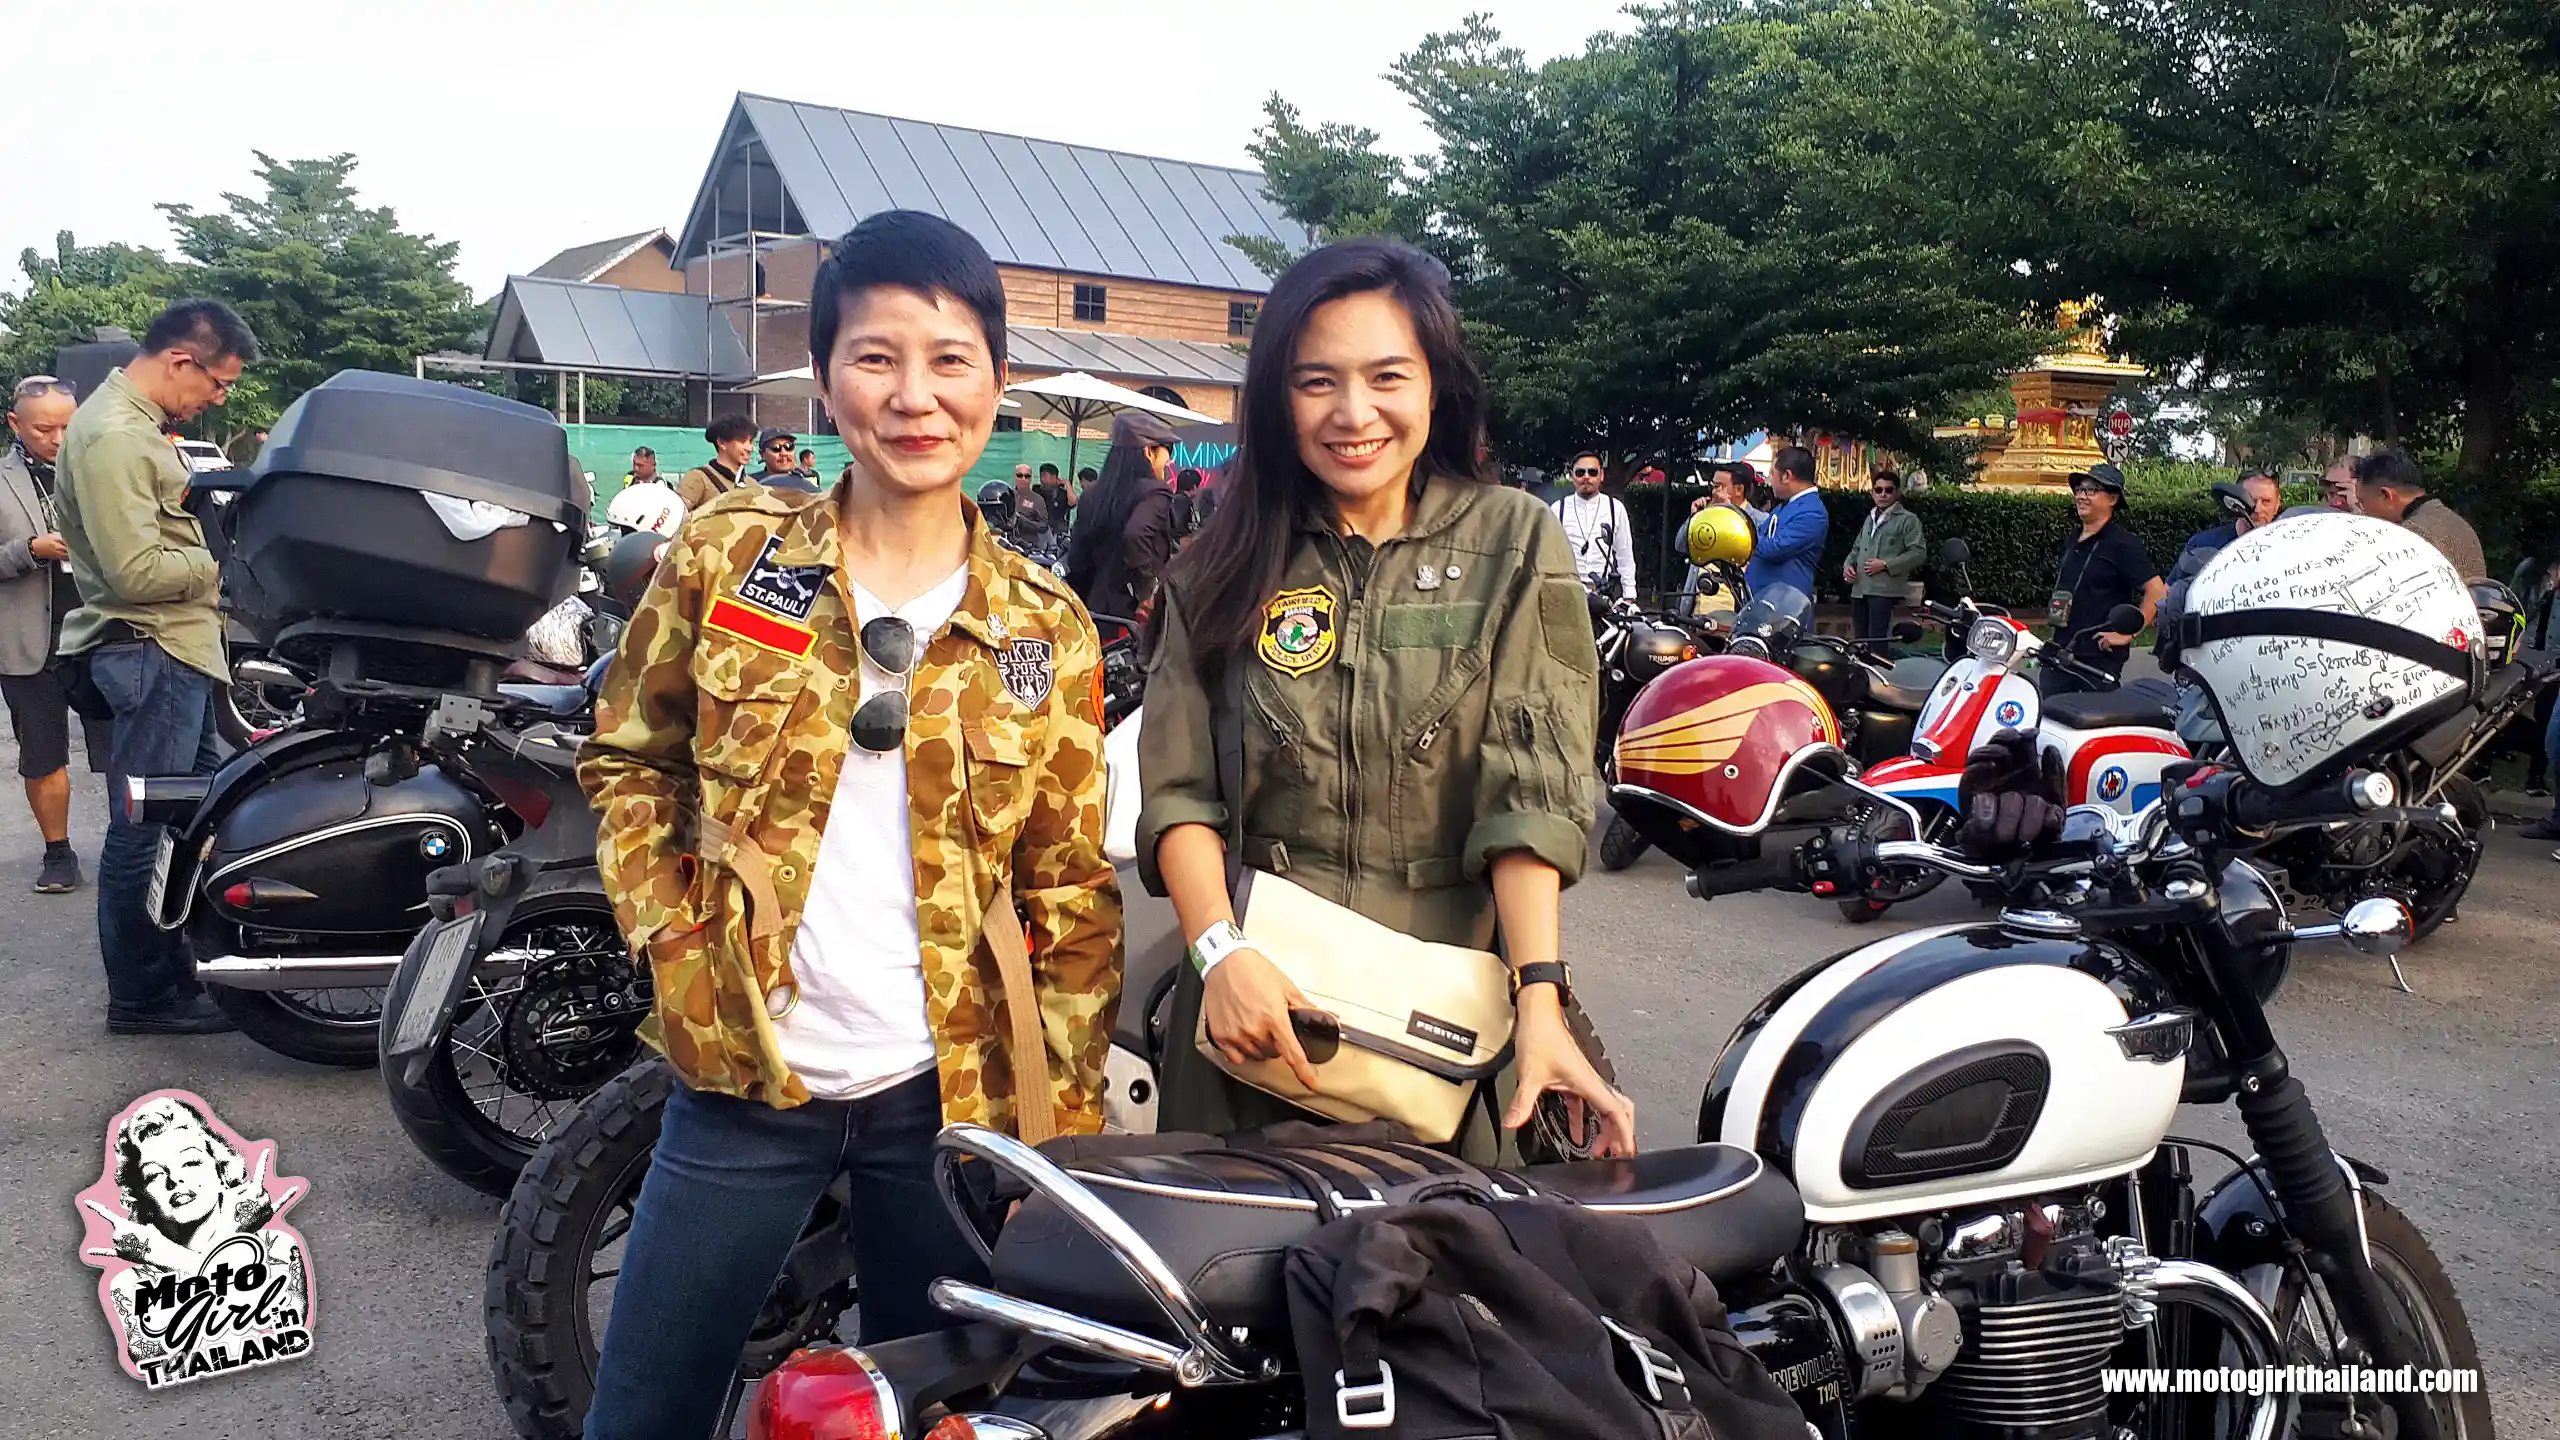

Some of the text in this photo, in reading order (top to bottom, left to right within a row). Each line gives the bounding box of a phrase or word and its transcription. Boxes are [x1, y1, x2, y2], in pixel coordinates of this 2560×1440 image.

[651, 507, 670, 534] MOTO
[1011, 662, 1041, 676] FOR
[1816, 1380, 1840, 1405] T120
